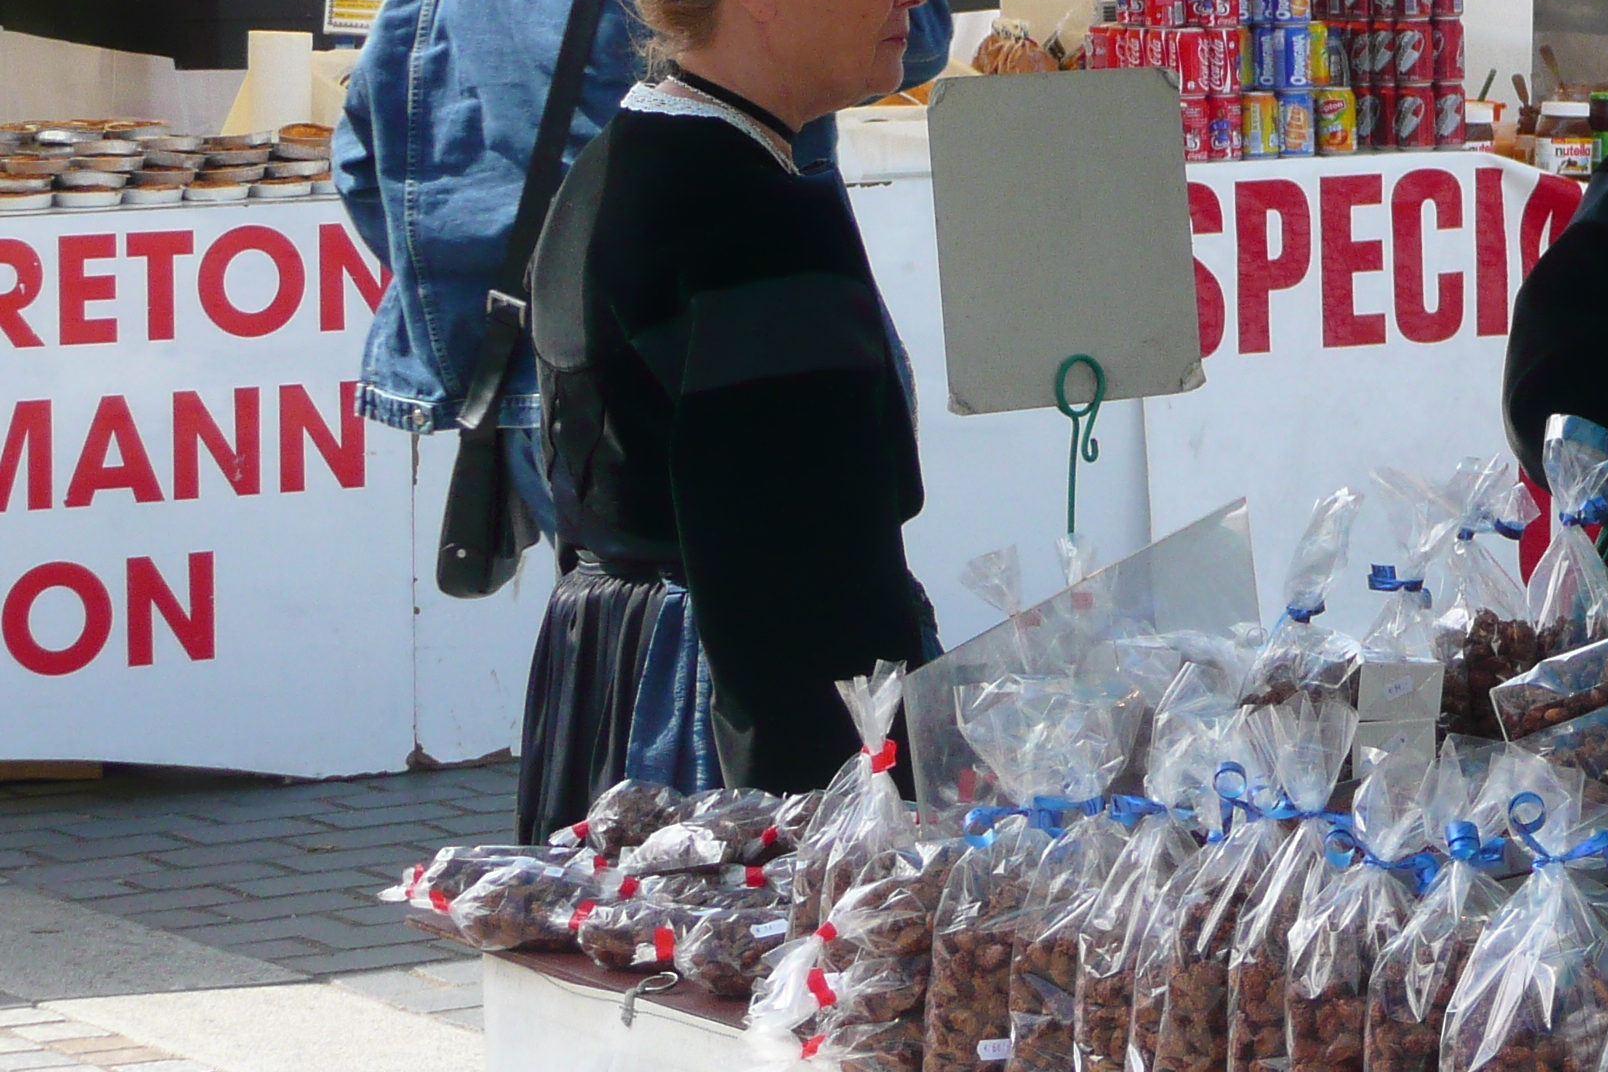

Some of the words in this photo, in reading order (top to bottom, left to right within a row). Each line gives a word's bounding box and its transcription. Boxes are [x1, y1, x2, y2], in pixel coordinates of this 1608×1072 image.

[1209, 37, 1225, 91] Coca-Cola
[1555, 143, 1592, 158] nutella
[2, 550, 216, 677] ON
